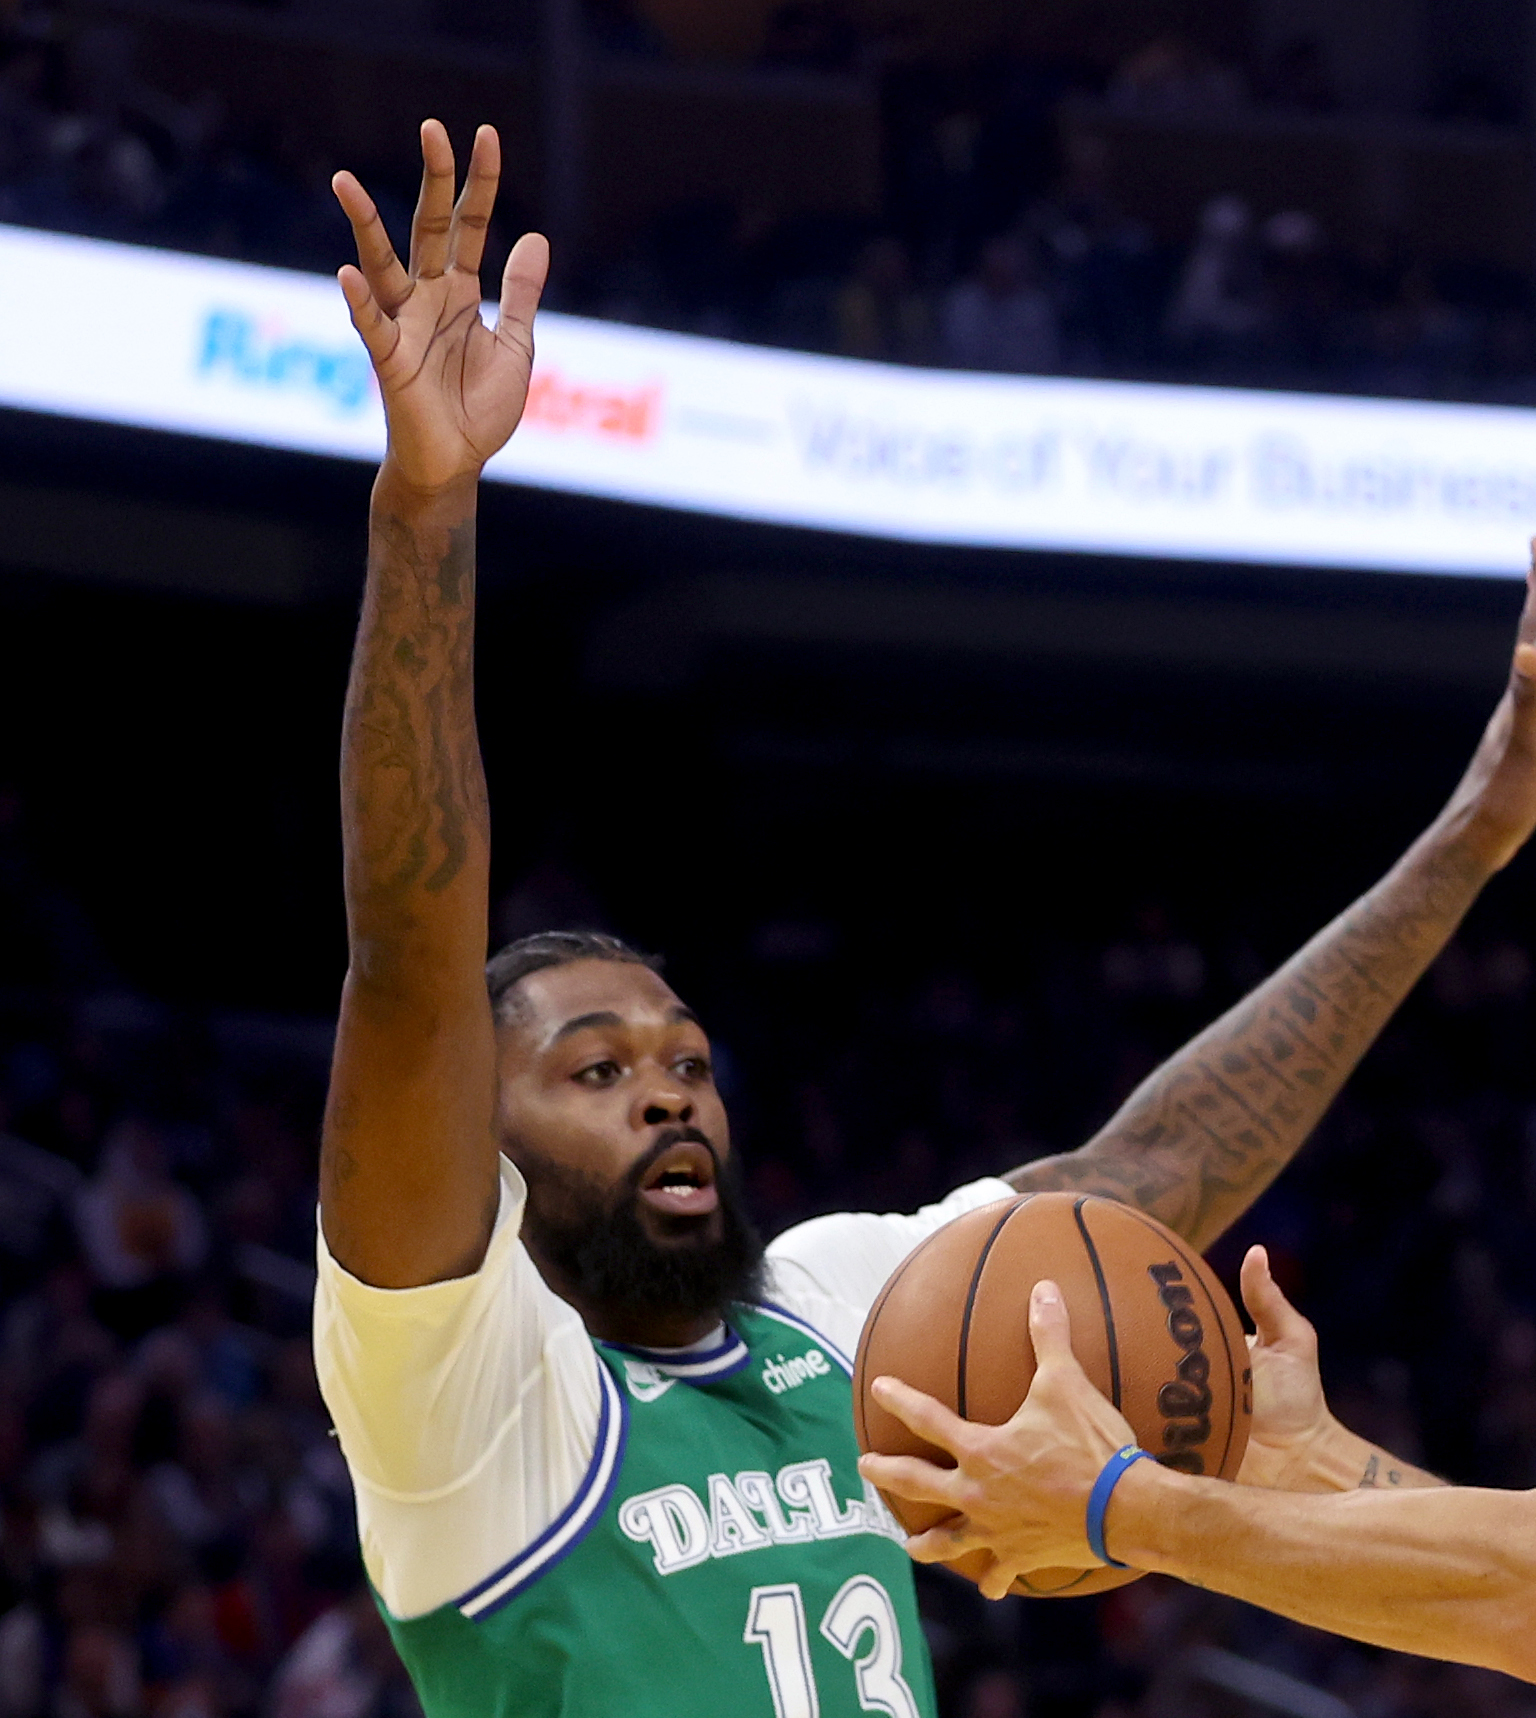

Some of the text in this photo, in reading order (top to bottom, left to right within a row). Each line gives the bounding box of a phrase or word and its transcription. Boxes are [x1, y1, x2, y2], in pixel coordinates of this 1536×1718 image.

[983, 424, 1056, 496] of
[1084, 420, 1232, 503] Your
[762, 1349, 832, 1395] chime
